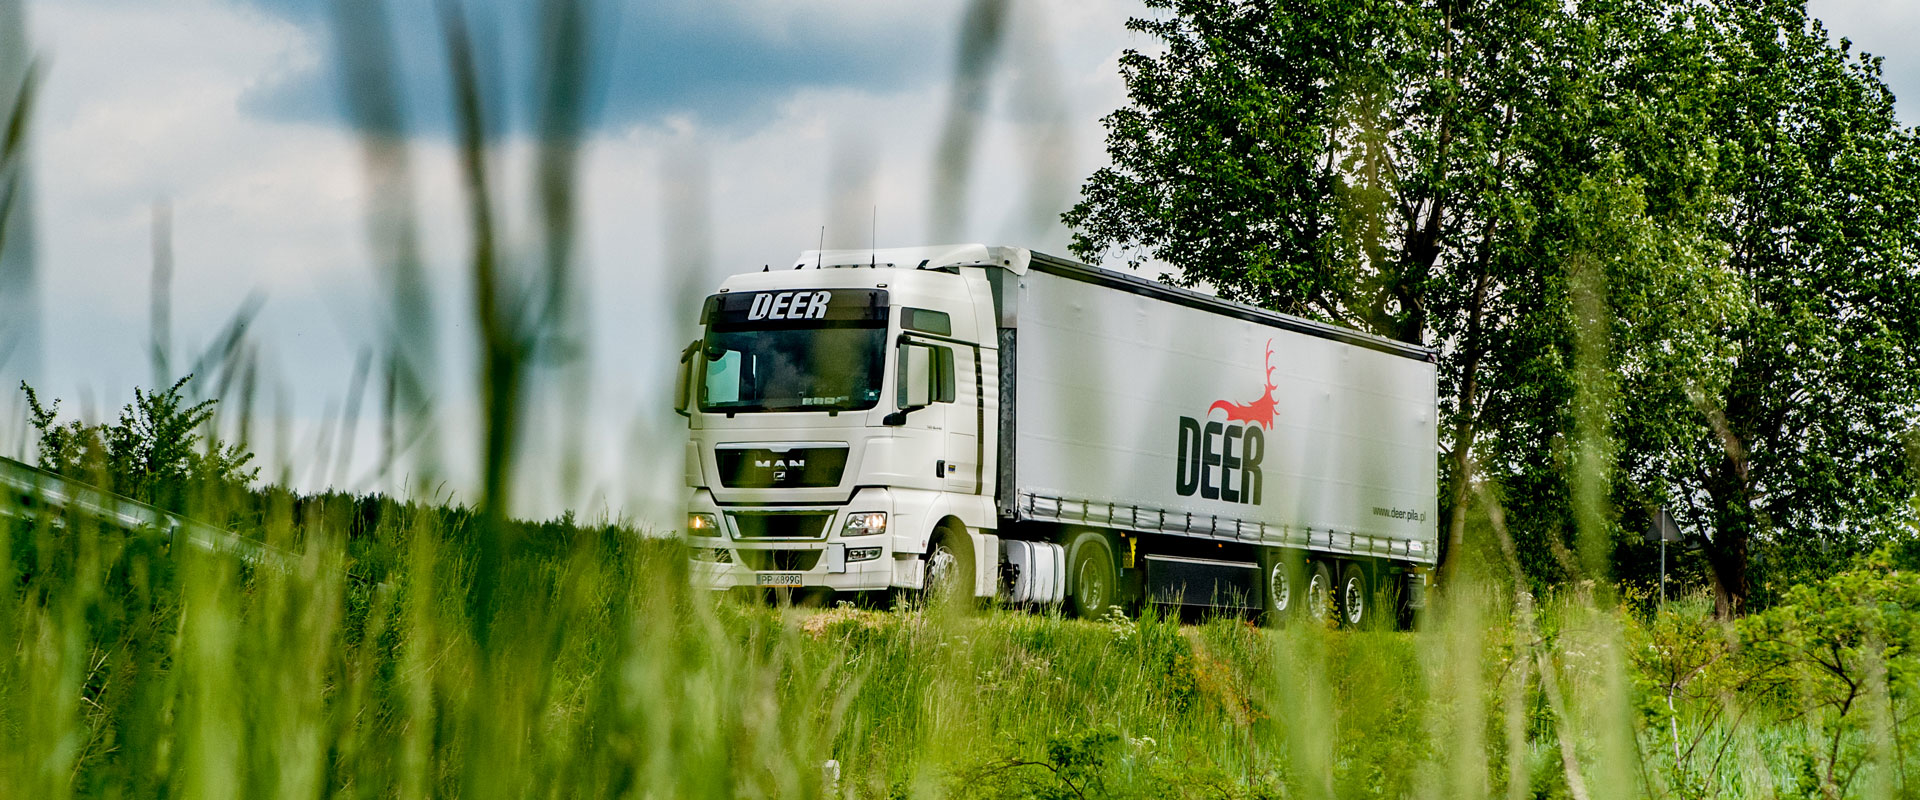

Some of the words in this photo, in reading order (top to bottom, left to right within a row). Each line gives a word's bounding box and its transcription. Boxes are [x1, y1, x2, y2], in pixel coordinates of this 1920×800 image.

[748, 291, 832, 320] DEER
[755, 459, 805, 470] MAN
[1176, 416, 1265, 505] DEER
[1372, 507, 1427, 524] www.deer.pila.pl
[761, 575, 773, 585] PP
